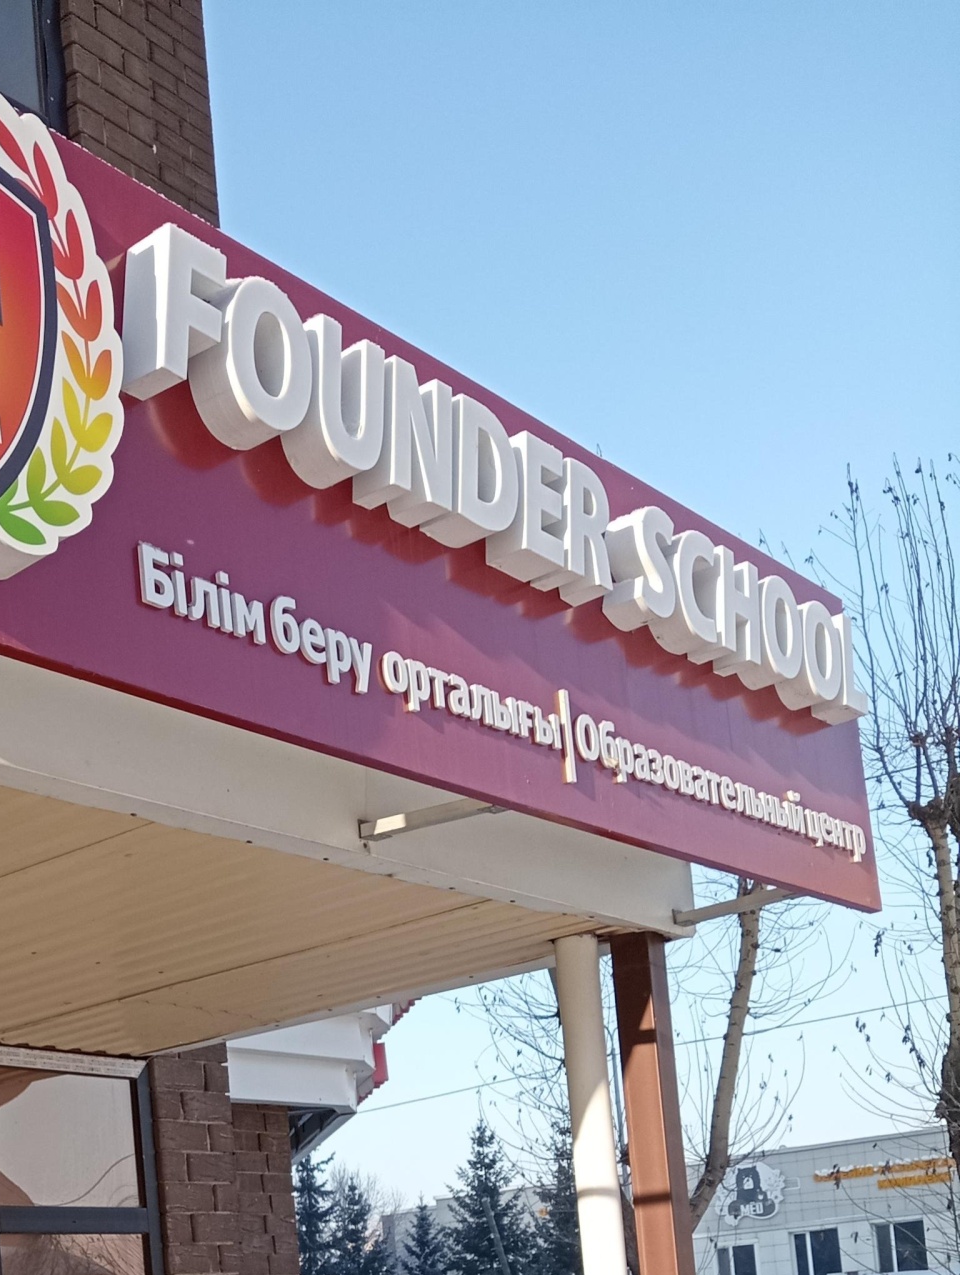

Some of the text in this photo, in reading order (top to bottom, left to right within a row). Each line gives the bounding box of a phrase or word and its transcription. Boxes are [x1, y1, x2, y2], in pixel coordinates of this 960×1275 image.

[122, 222, 868, 725] FOUNDER SCHOOL
[137, 541, 266, 646] Білім
[270, 595, 372, 694] беру
[381, 650, 562, 750] орталығы
[575, 714, 807, 836] Образовательный
[805, 807, 867, 864] центр
